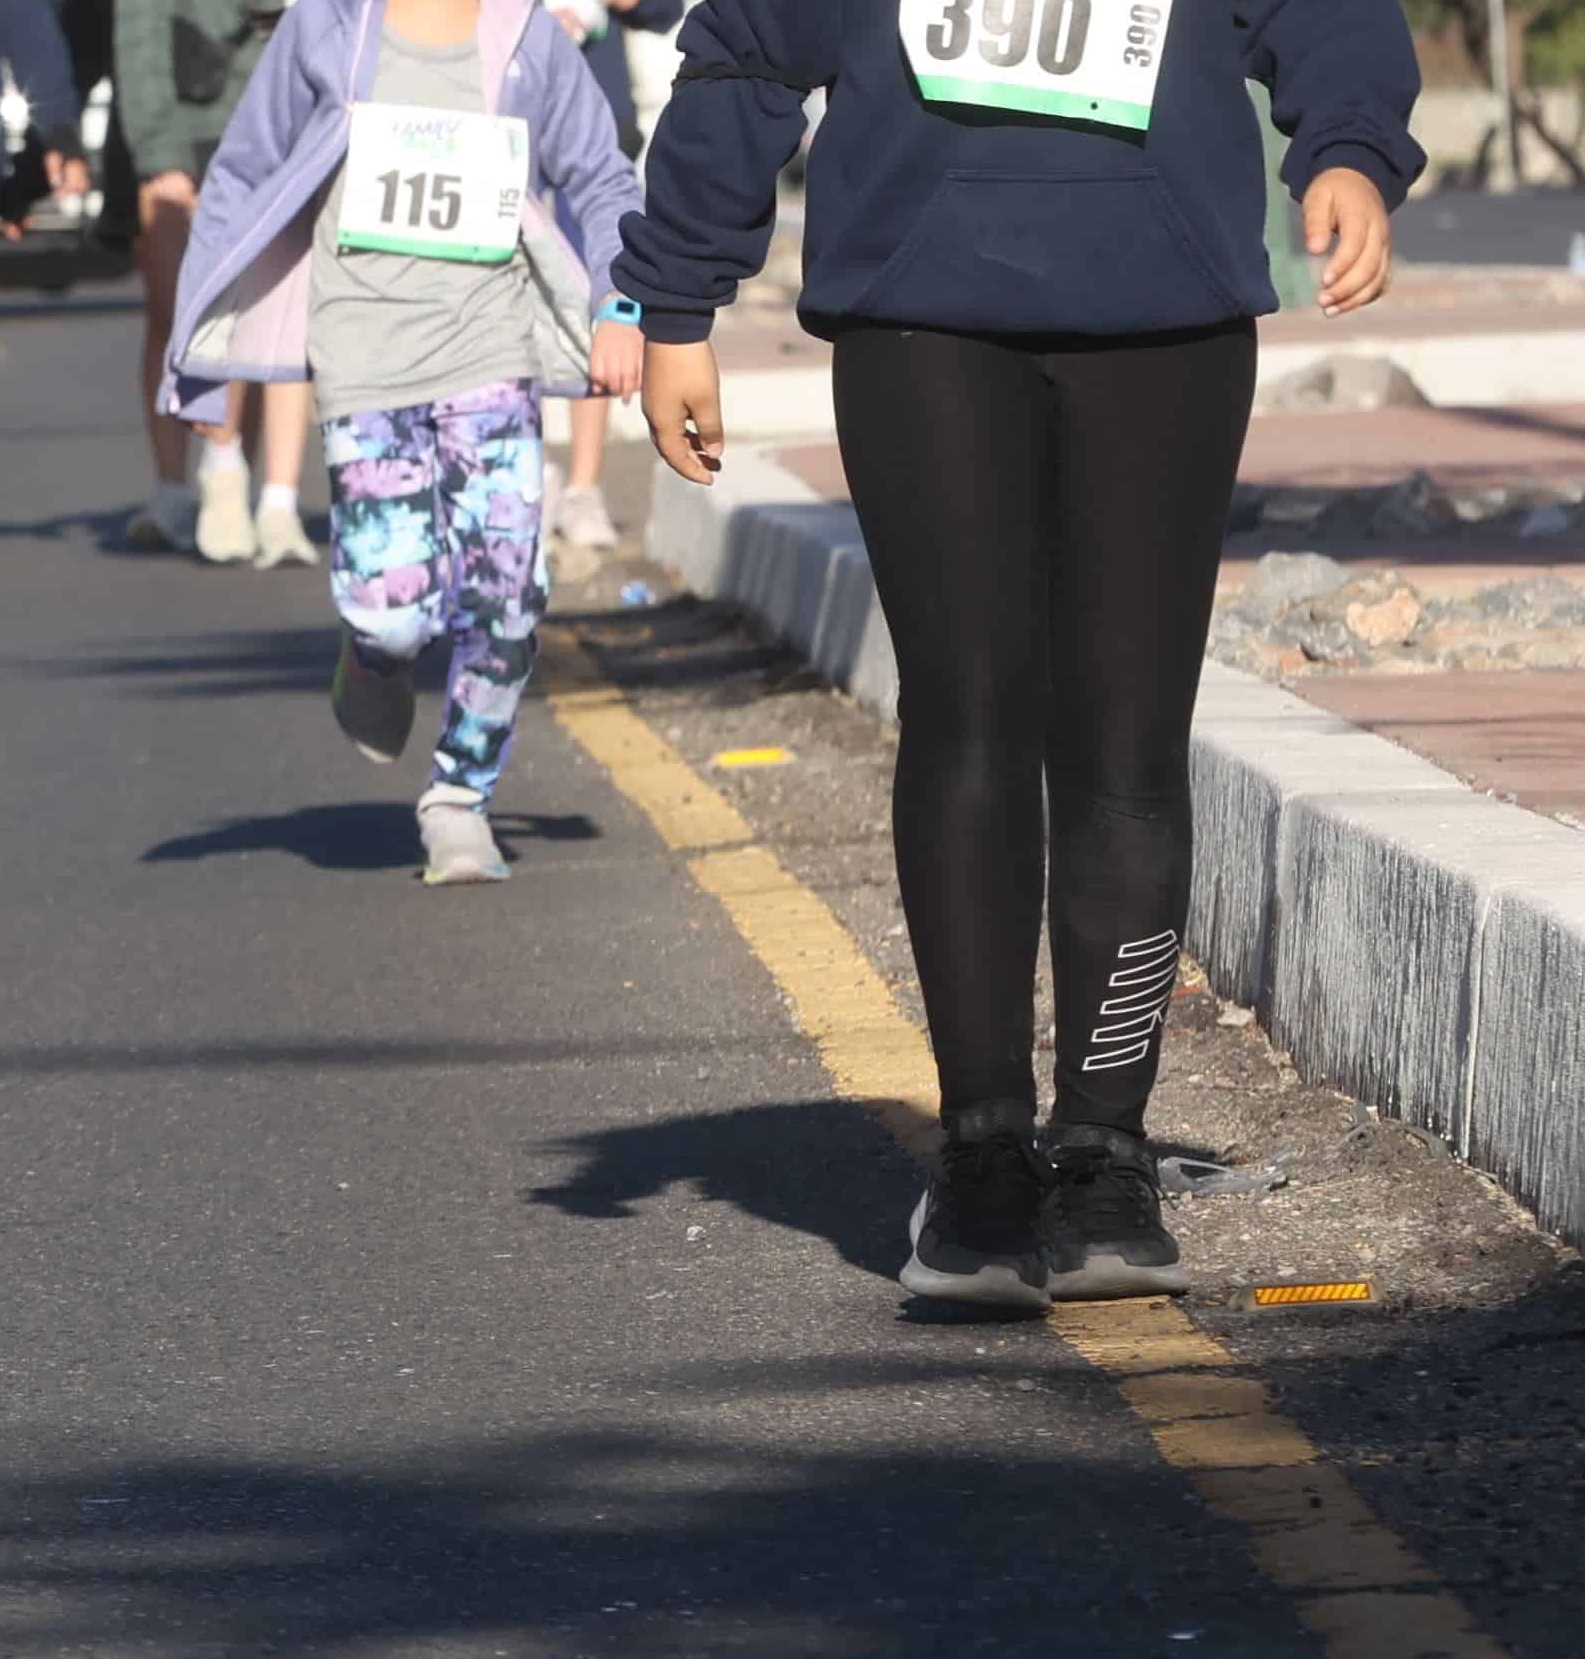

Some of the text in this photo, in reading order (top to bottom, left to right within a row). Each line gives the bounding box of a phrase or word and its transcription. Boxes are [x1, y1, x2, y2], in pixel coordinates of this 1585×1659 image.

[1123, 4, 1161, 68] 390
[376, 169, 462, 231] 115
[497, 188, 520, 218] 115
